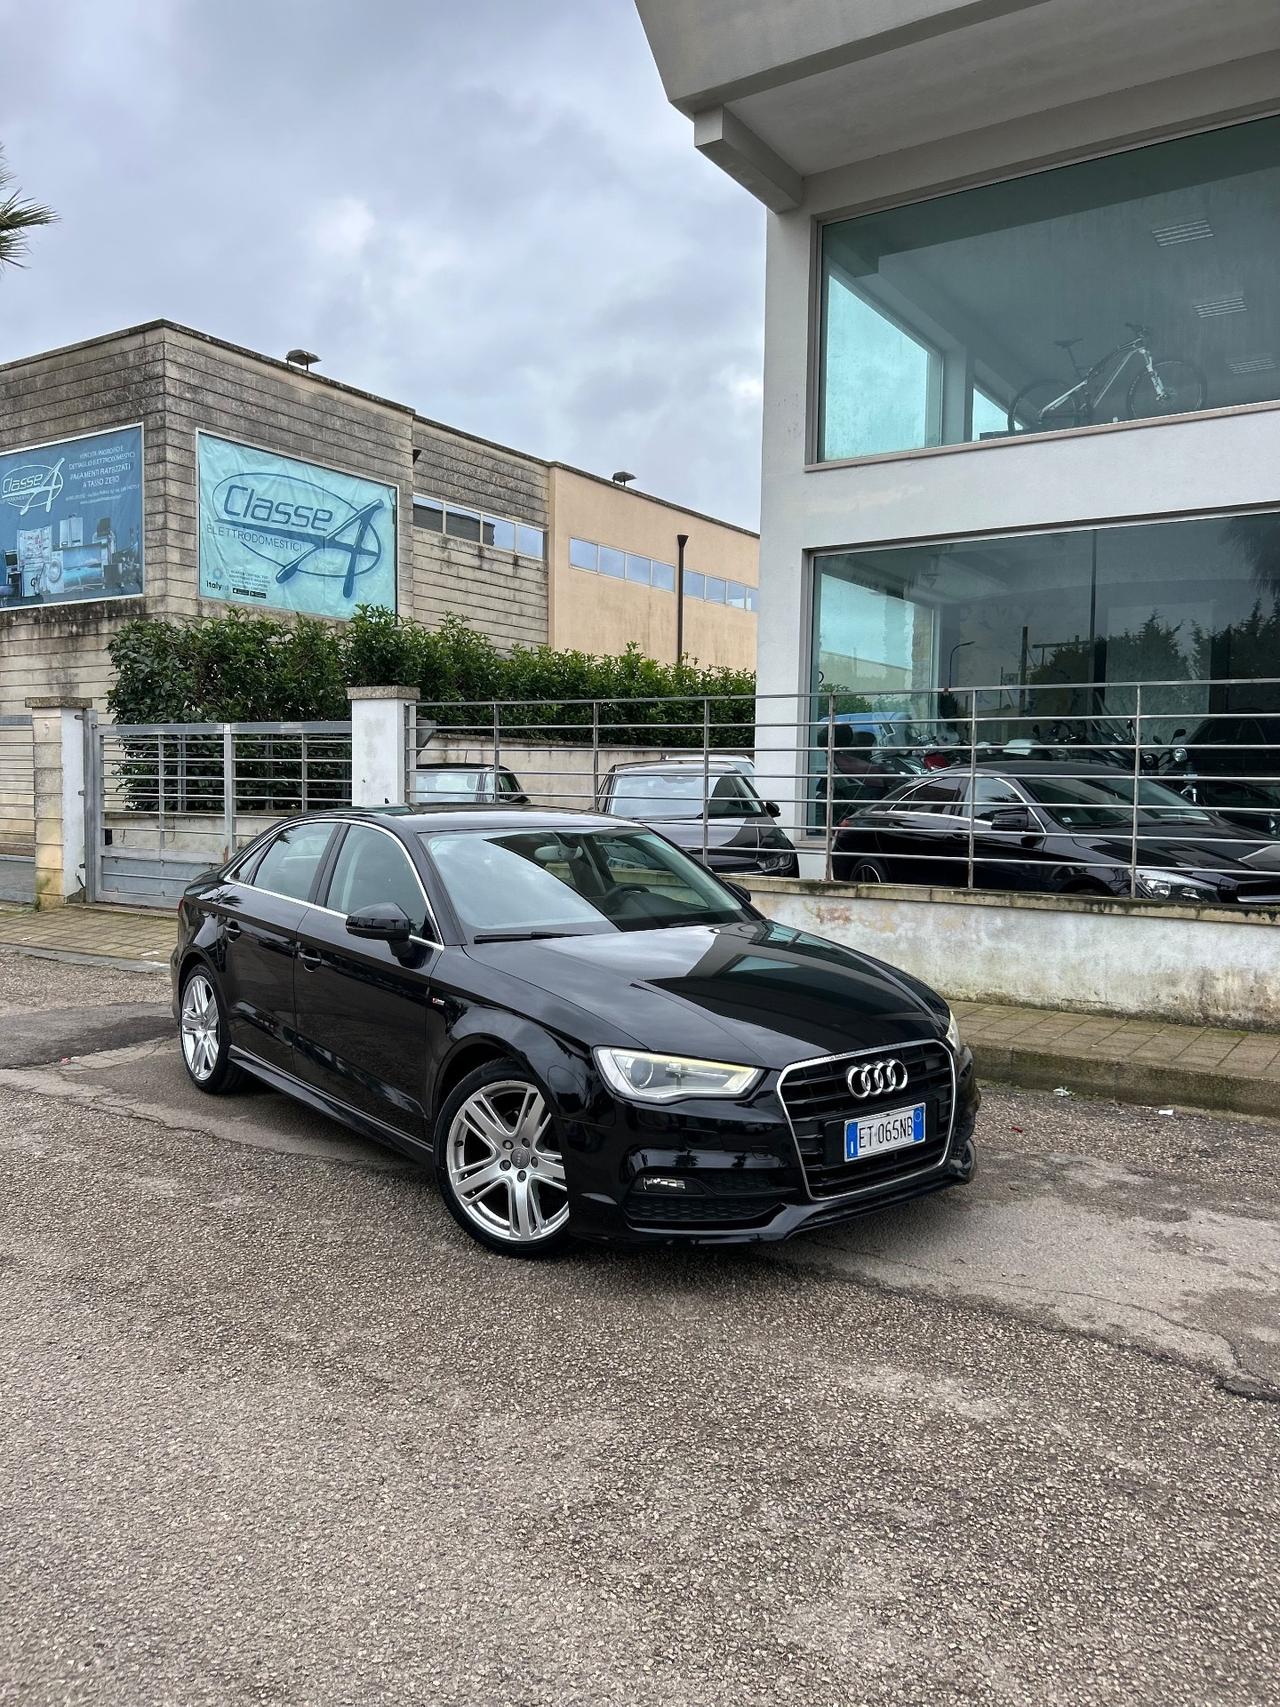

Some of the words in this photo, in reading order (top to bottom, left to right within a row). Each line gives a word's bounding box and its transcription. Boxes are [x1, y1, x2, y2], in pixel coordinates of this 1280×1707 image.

[3, 473, 44, 493] Classe
[104, 475, 120, 485] ZERO
[223, 484, 333, 532] Classe
[859, 1124, 874, 1149] ET
[877, 1116, 913, 1144] 065NB
